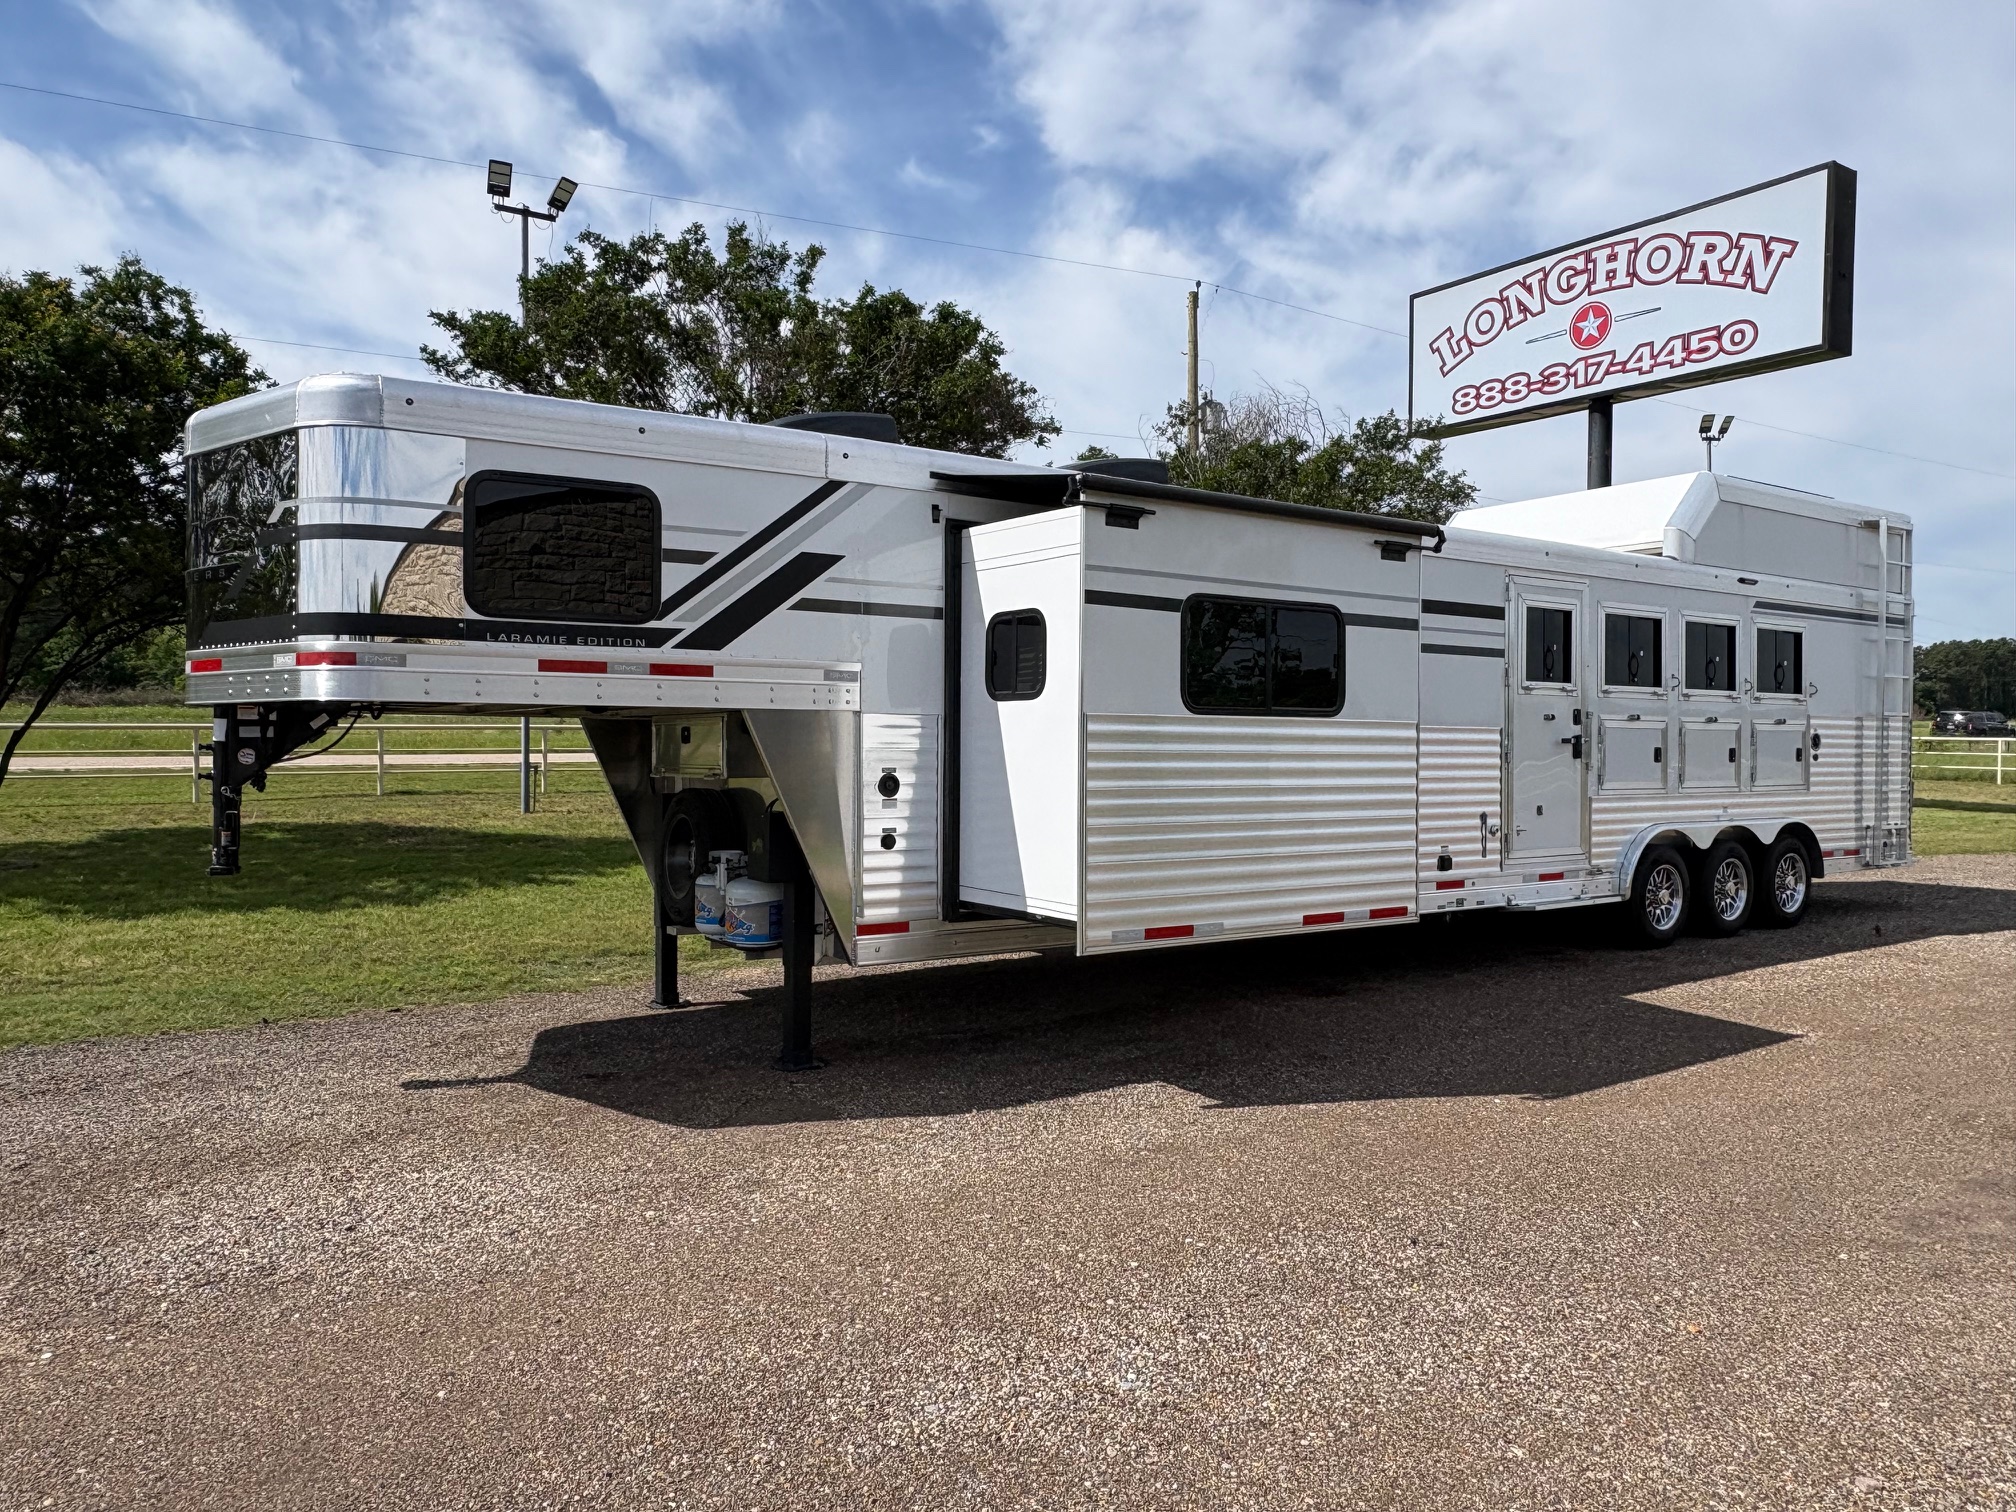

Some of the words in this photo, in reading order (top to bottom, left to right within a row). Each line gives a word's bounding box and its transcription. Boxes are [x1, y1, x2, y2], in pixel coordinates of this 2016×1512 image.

[1430, 231, 1799, 377] LONGHORN
[1453, 319, 1759, 415] 888-317-4450
[487, 632, 568, 645] LARAMIE
[577, 636, 646, 648] EDITION
